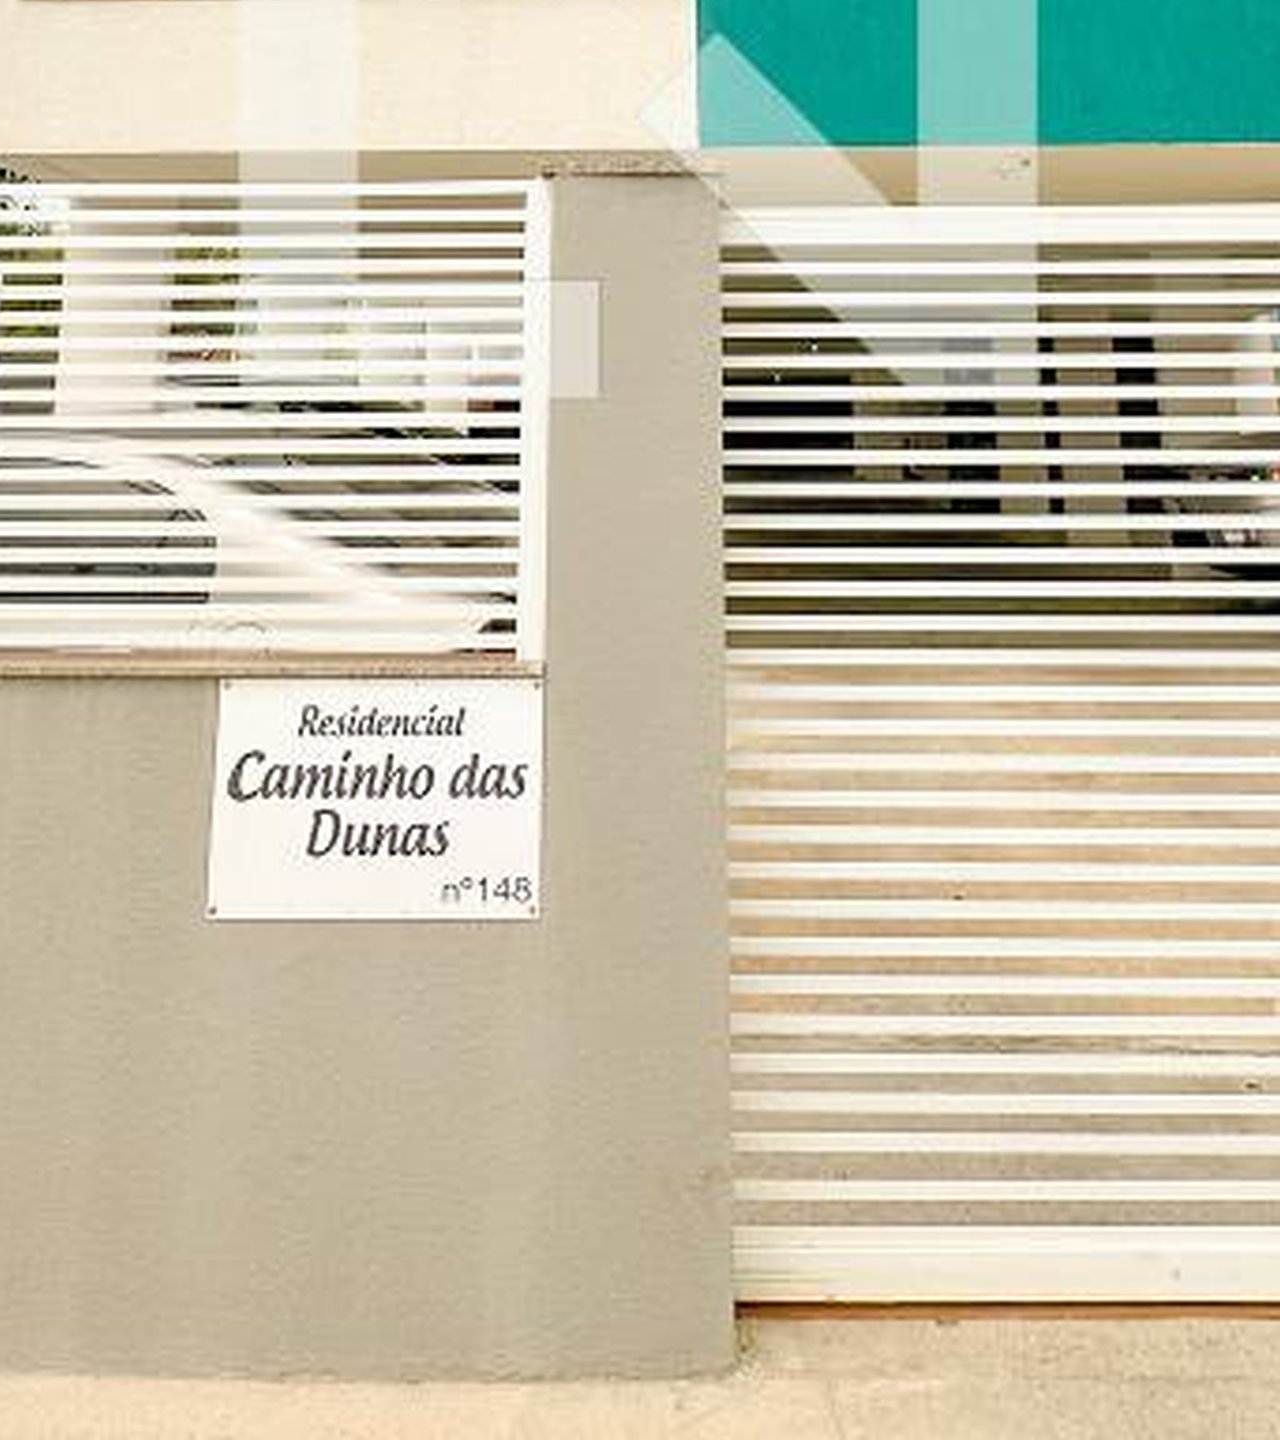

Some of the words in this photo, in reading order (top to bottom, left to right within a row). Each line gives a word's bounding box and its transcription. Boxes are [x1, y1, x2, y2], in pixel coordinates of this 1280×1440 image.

[297, 704, 466, 738] Residencial
[226, 749, 436, 803] Caminho
[447, 752, 528, 800] das
[305, 808, 450, 858] Dunas
